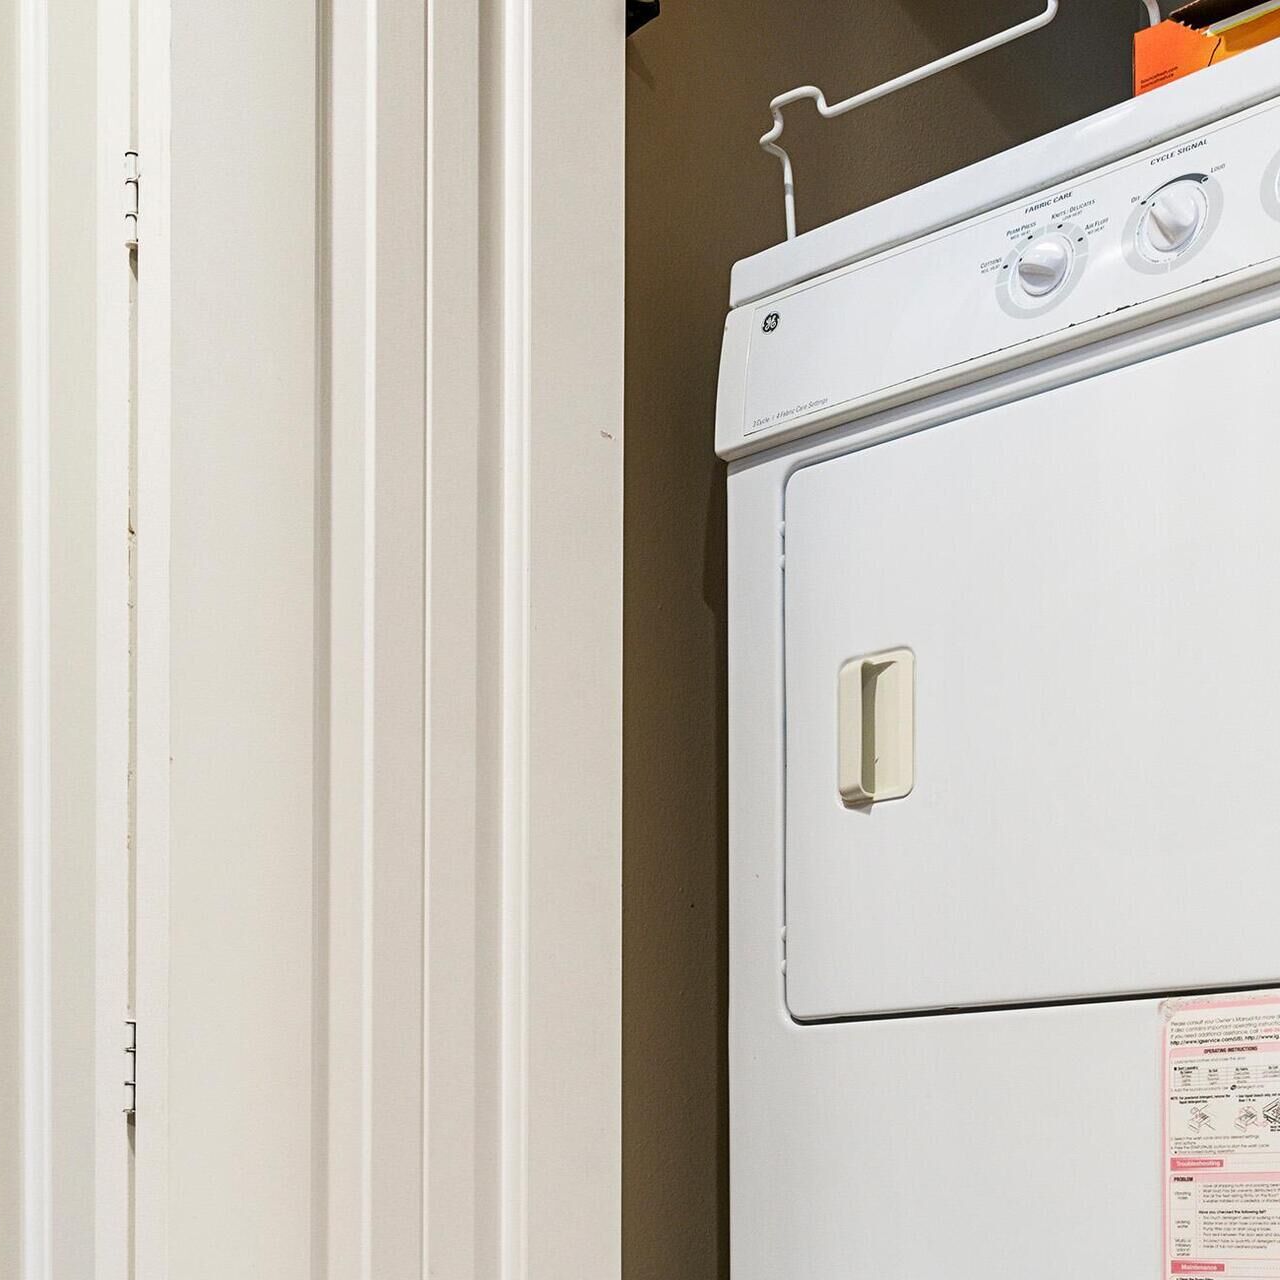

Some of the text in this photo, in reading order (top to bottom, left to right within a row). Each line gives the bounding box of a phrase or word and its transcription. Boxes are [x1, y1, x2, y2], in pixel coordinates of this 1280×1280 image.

[1150, 138, 1208, 166] CYCLE SIGNAL
[1025, 192, 1073, 214] FABRIC CARE
